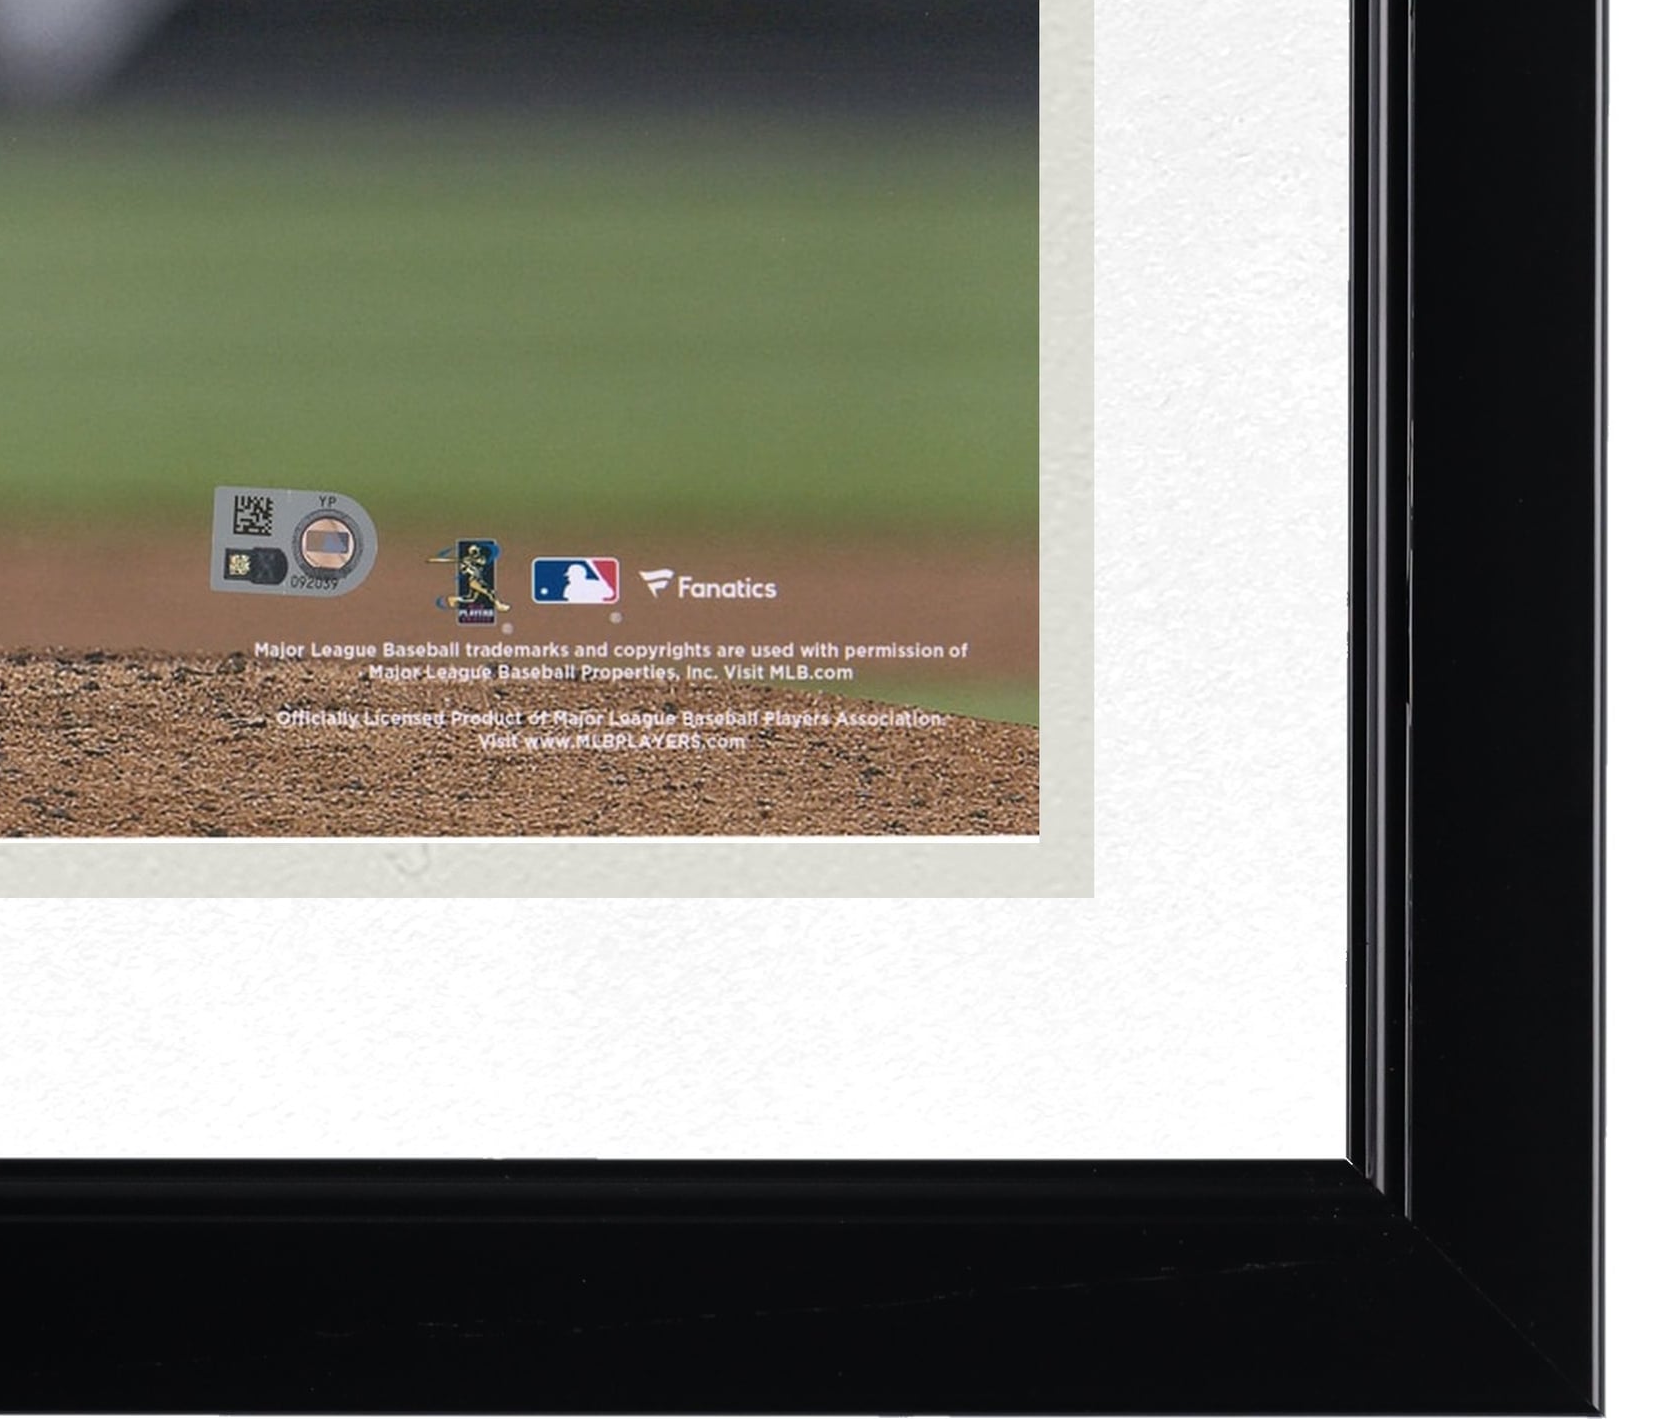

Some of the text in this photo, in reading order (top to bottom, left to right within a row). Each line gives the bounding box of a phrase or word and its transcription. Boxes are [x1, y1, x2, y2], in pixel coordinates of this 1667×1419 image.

[319, 496, 337, 507] YP
[678, 576, 778, 598] Fanatics
[254, 642, 968, 661] Major League Baseball trademarks and copyrights are used with permission of
[369, 664, 854, 683] Major League Baseball Properties, Inc. Visit MLB.com
[276, 711, 359, 729] Officially
[365, 711, 445, 727] Licensed
[451, 711, 522, 727] Product
[527, 711, 551, 727] of
[553, 711, 604, 729] Major
[610, 711, 677, 729] League
[682, 711, 760, 727] Baseball
[766, 711, 830, 729] Players
[478, 734, 746, 750] Visit www.MLBPLAYERS.com
